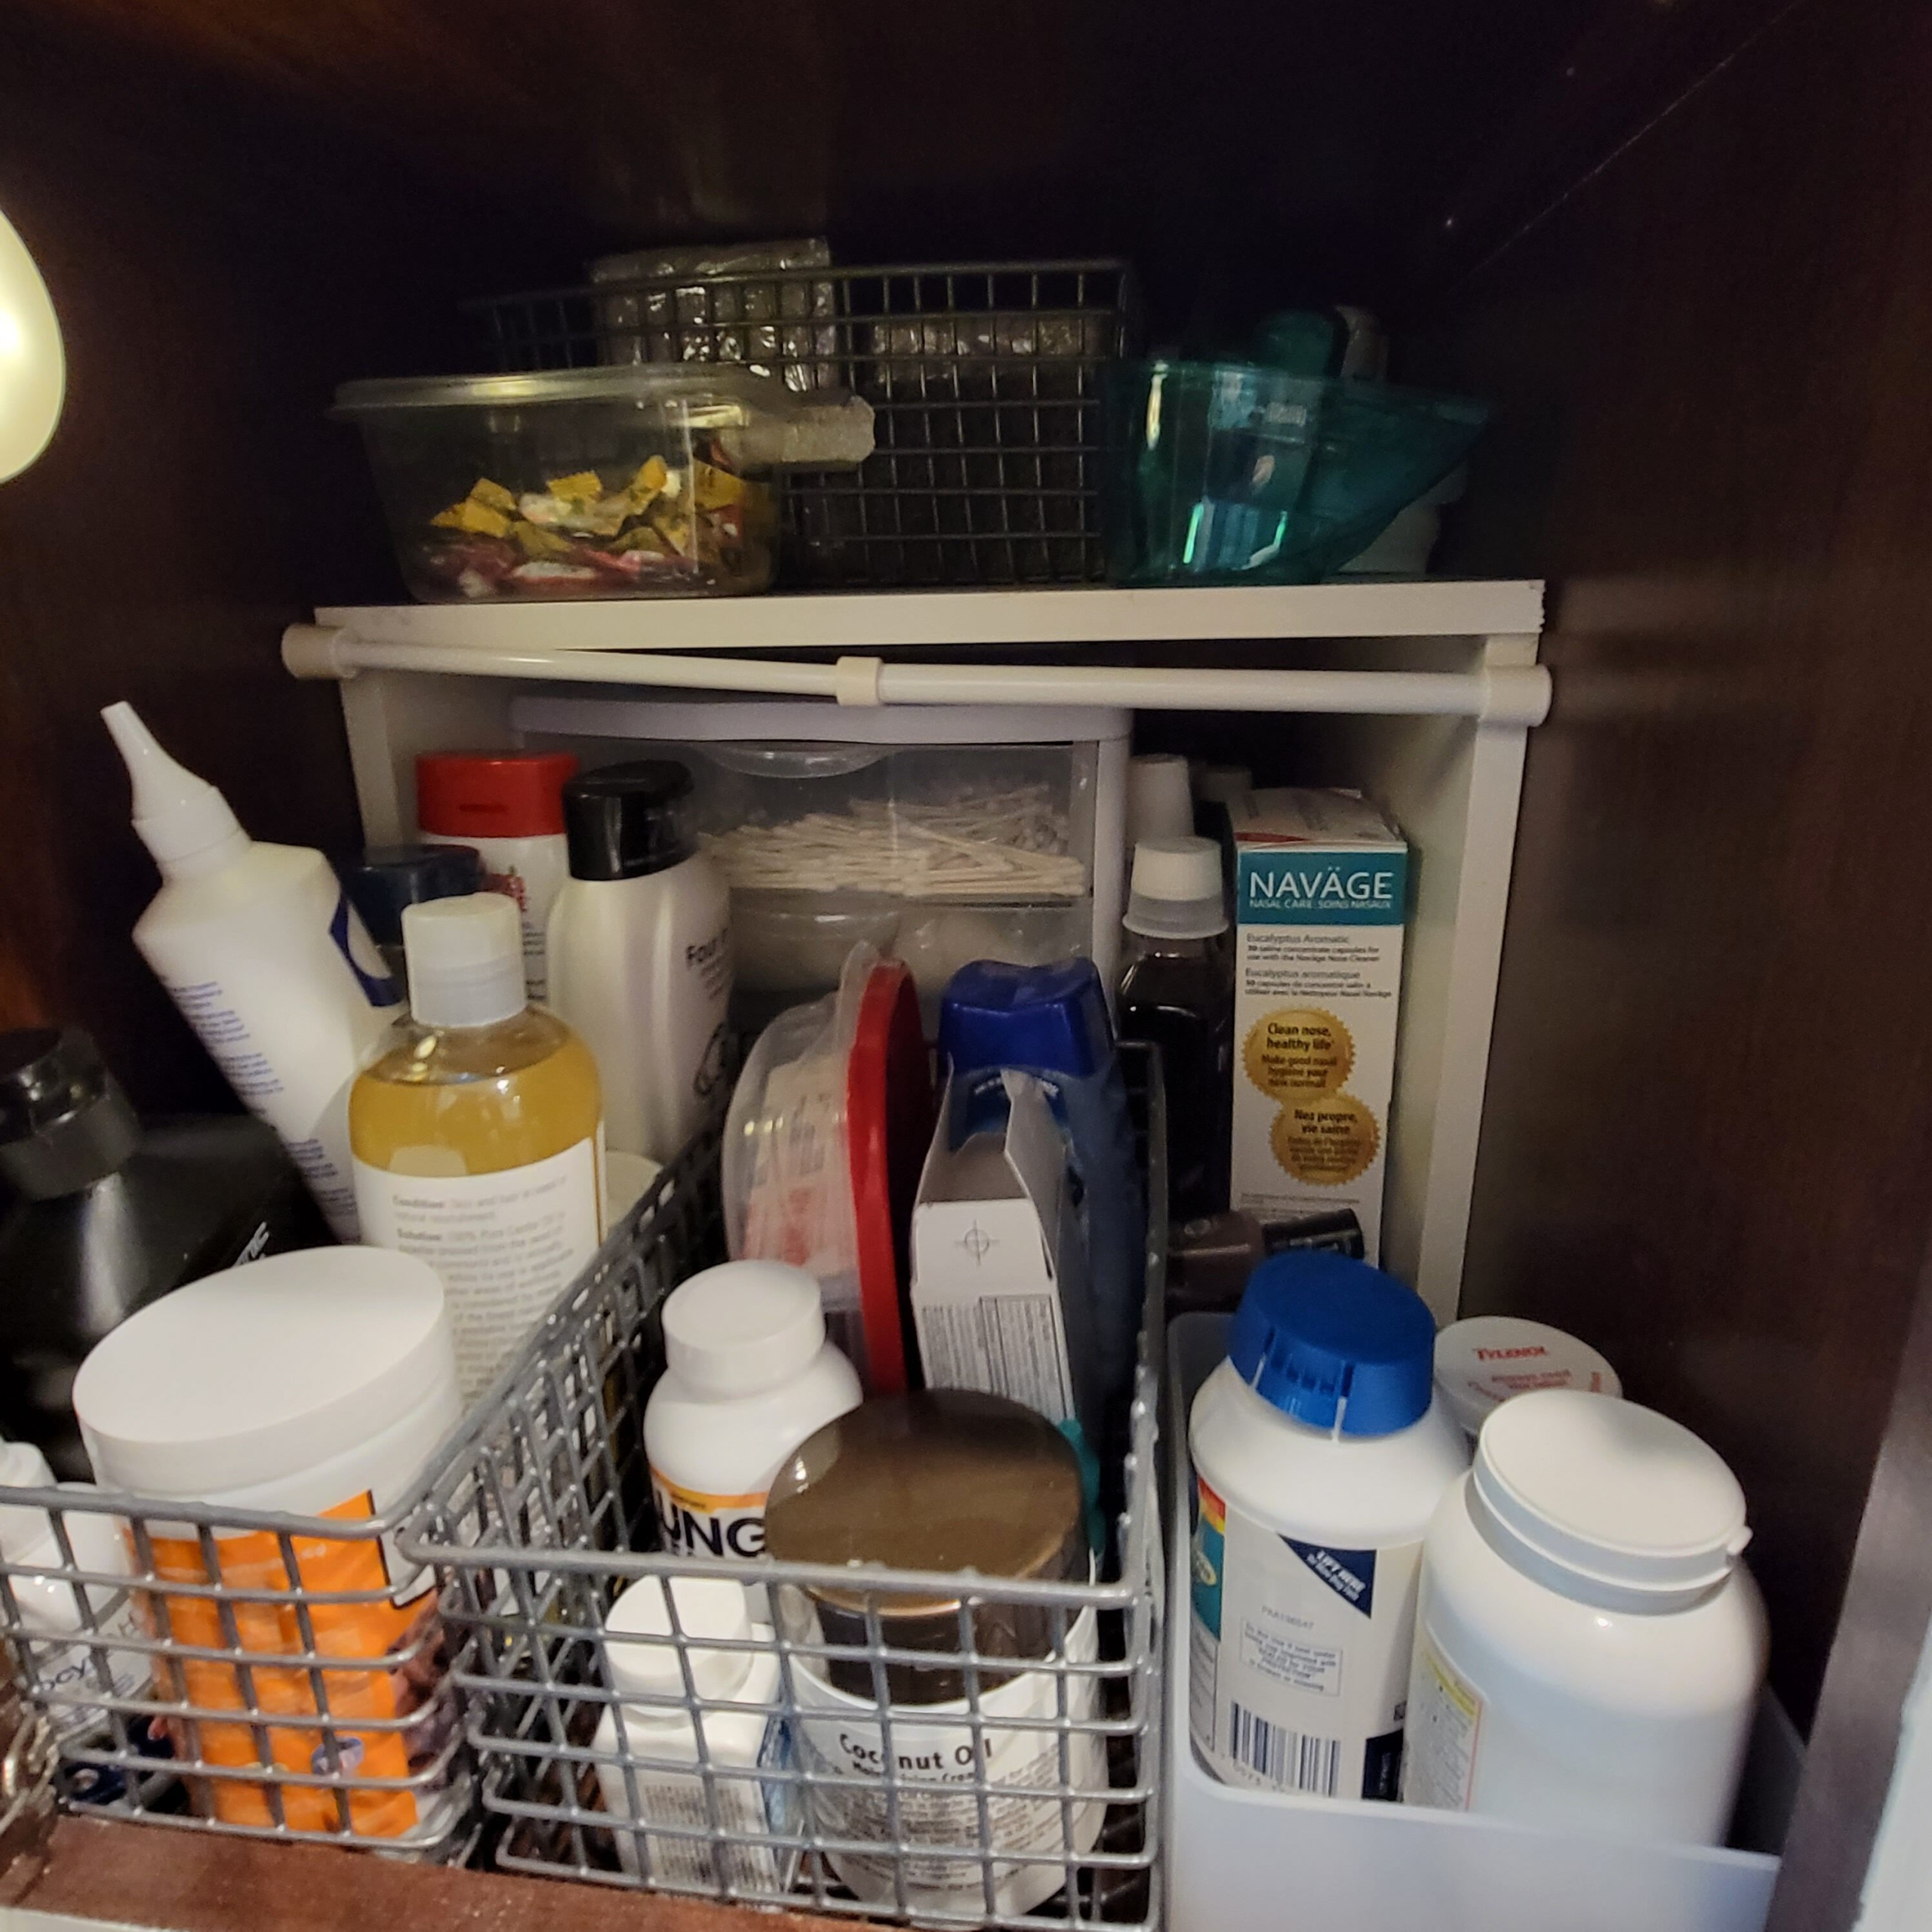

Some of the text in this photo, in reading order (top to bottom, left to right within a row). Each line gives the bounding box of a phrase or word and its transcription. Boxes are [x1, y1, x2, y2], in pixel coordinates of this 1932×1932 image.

[1249, 866, 1394, 899] NAVÄGE
[1247, 933, 1349, 945] Eucalyptus Aromatic
[1245, 968, 1299, 979] Eucalyptus
[1267, 1022, 1331, 1037] Clean nose,
[1266, 1036, 1310, 1051] healthy
[840, 1733, 992, 1770] Cocnut Ol
